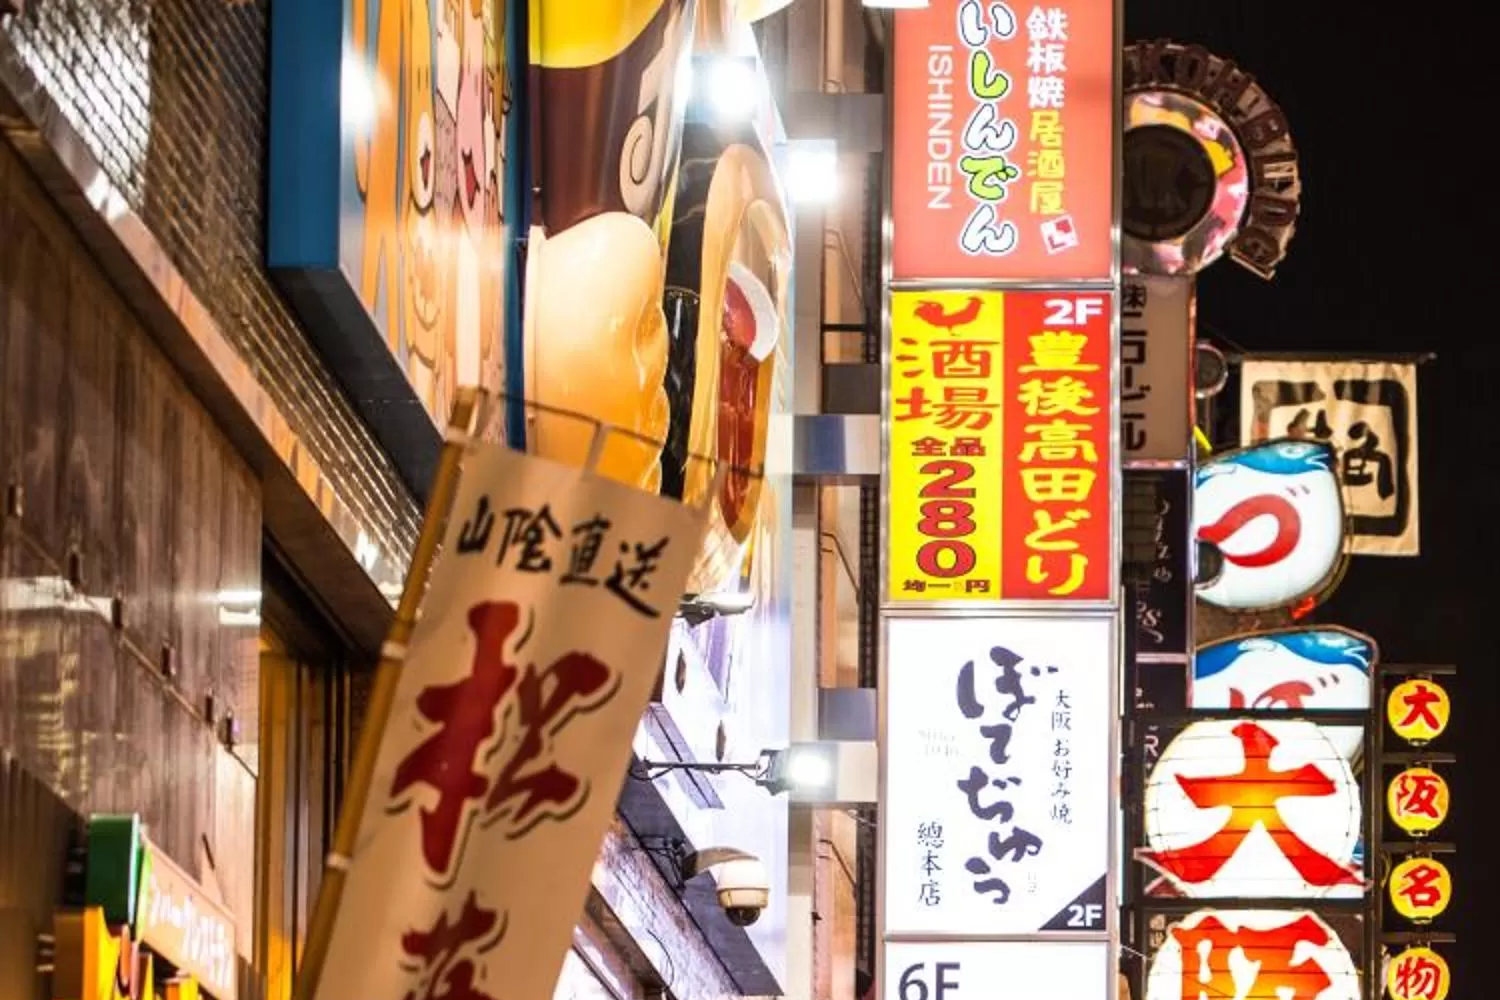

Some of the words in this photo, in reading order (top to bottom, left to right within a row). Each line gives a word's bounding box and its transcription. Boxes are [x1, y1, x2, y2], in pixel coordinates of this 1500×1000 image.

[927, 45, 953, 210] ISHINDEN
[960, 0, 1017, 256] いしんでん
[1026, 6, 1068, 216] 鉄板焼居酒屋
[1043, 299, 1103, 325] 2F
[894, 336, 1000, 430] 酒場
[910, 435, 987, 457] 全品
[1015, 330, 1101, 596] 豊後高田どり
[457, 494, 672, 621] 山陰直送
[916, 460, 978, 578] 280
[1067, 905, 1103, 927] 2F
